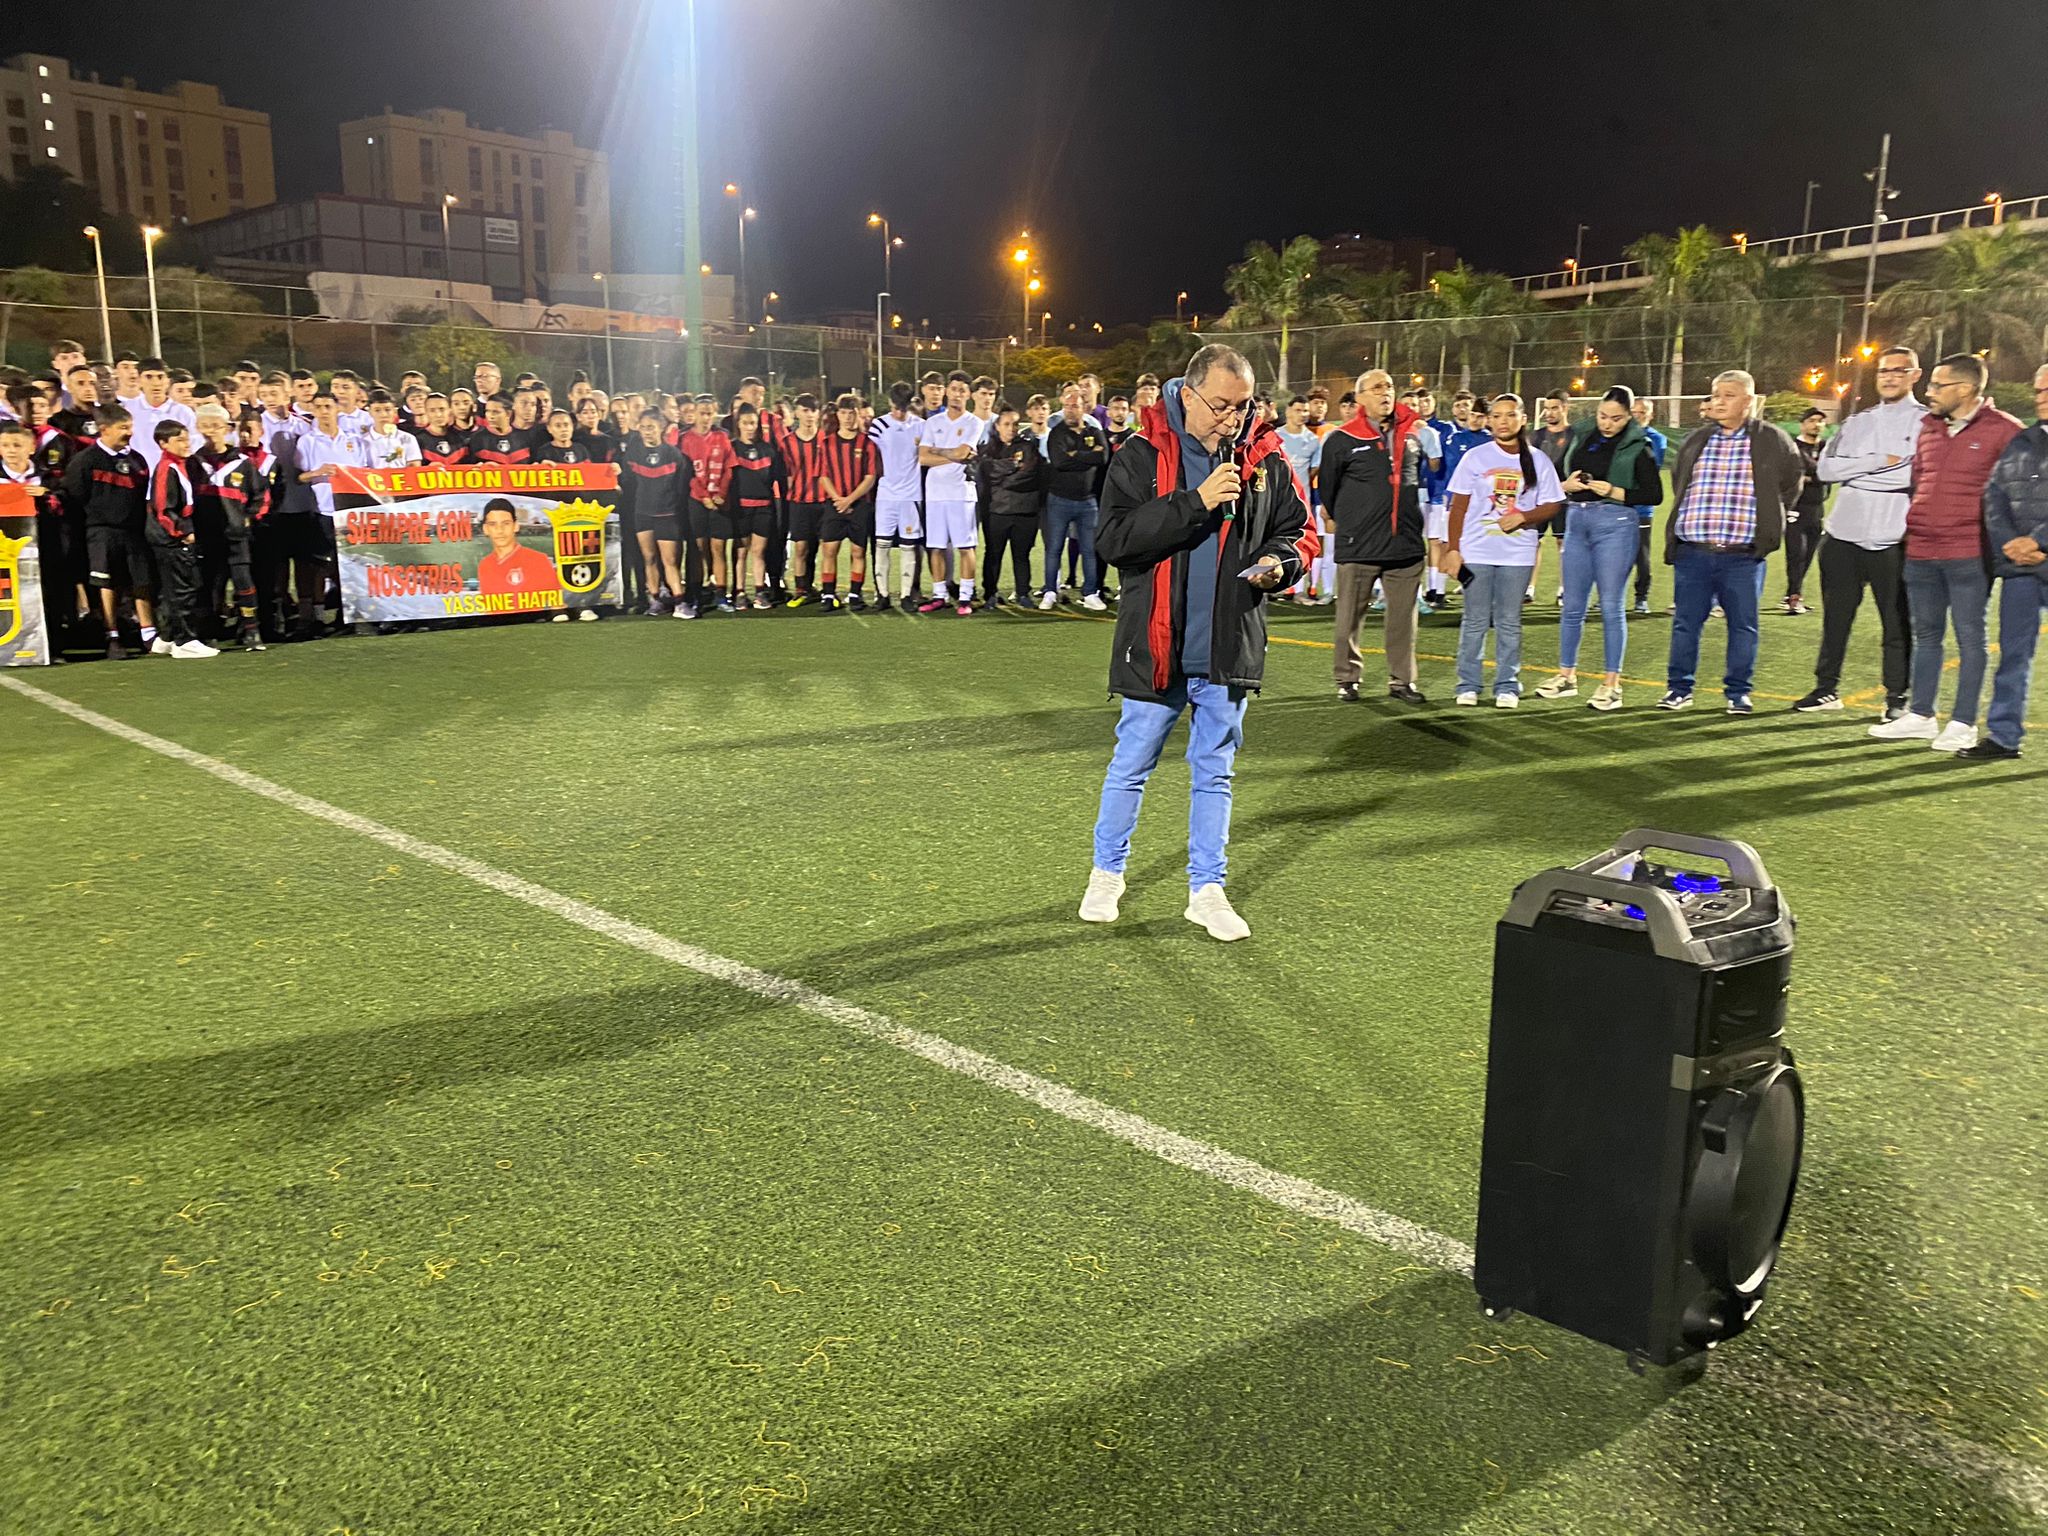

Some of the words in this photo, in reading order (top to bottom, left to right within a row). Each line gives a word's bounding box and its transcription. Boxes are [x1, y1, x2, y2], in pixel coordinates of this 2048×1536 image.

[366, 473, 413, 492] C.F.
[508, 469, 585, 488] VIERA
[346, 511, 432, 545] SIEMPRE
[436, 510, 473, 542] CON
[367, 563, 464, 598] NOSOTROS
[442, 592, 515, 615] YASSINE
[518, 589, 564, 610] HATRI
